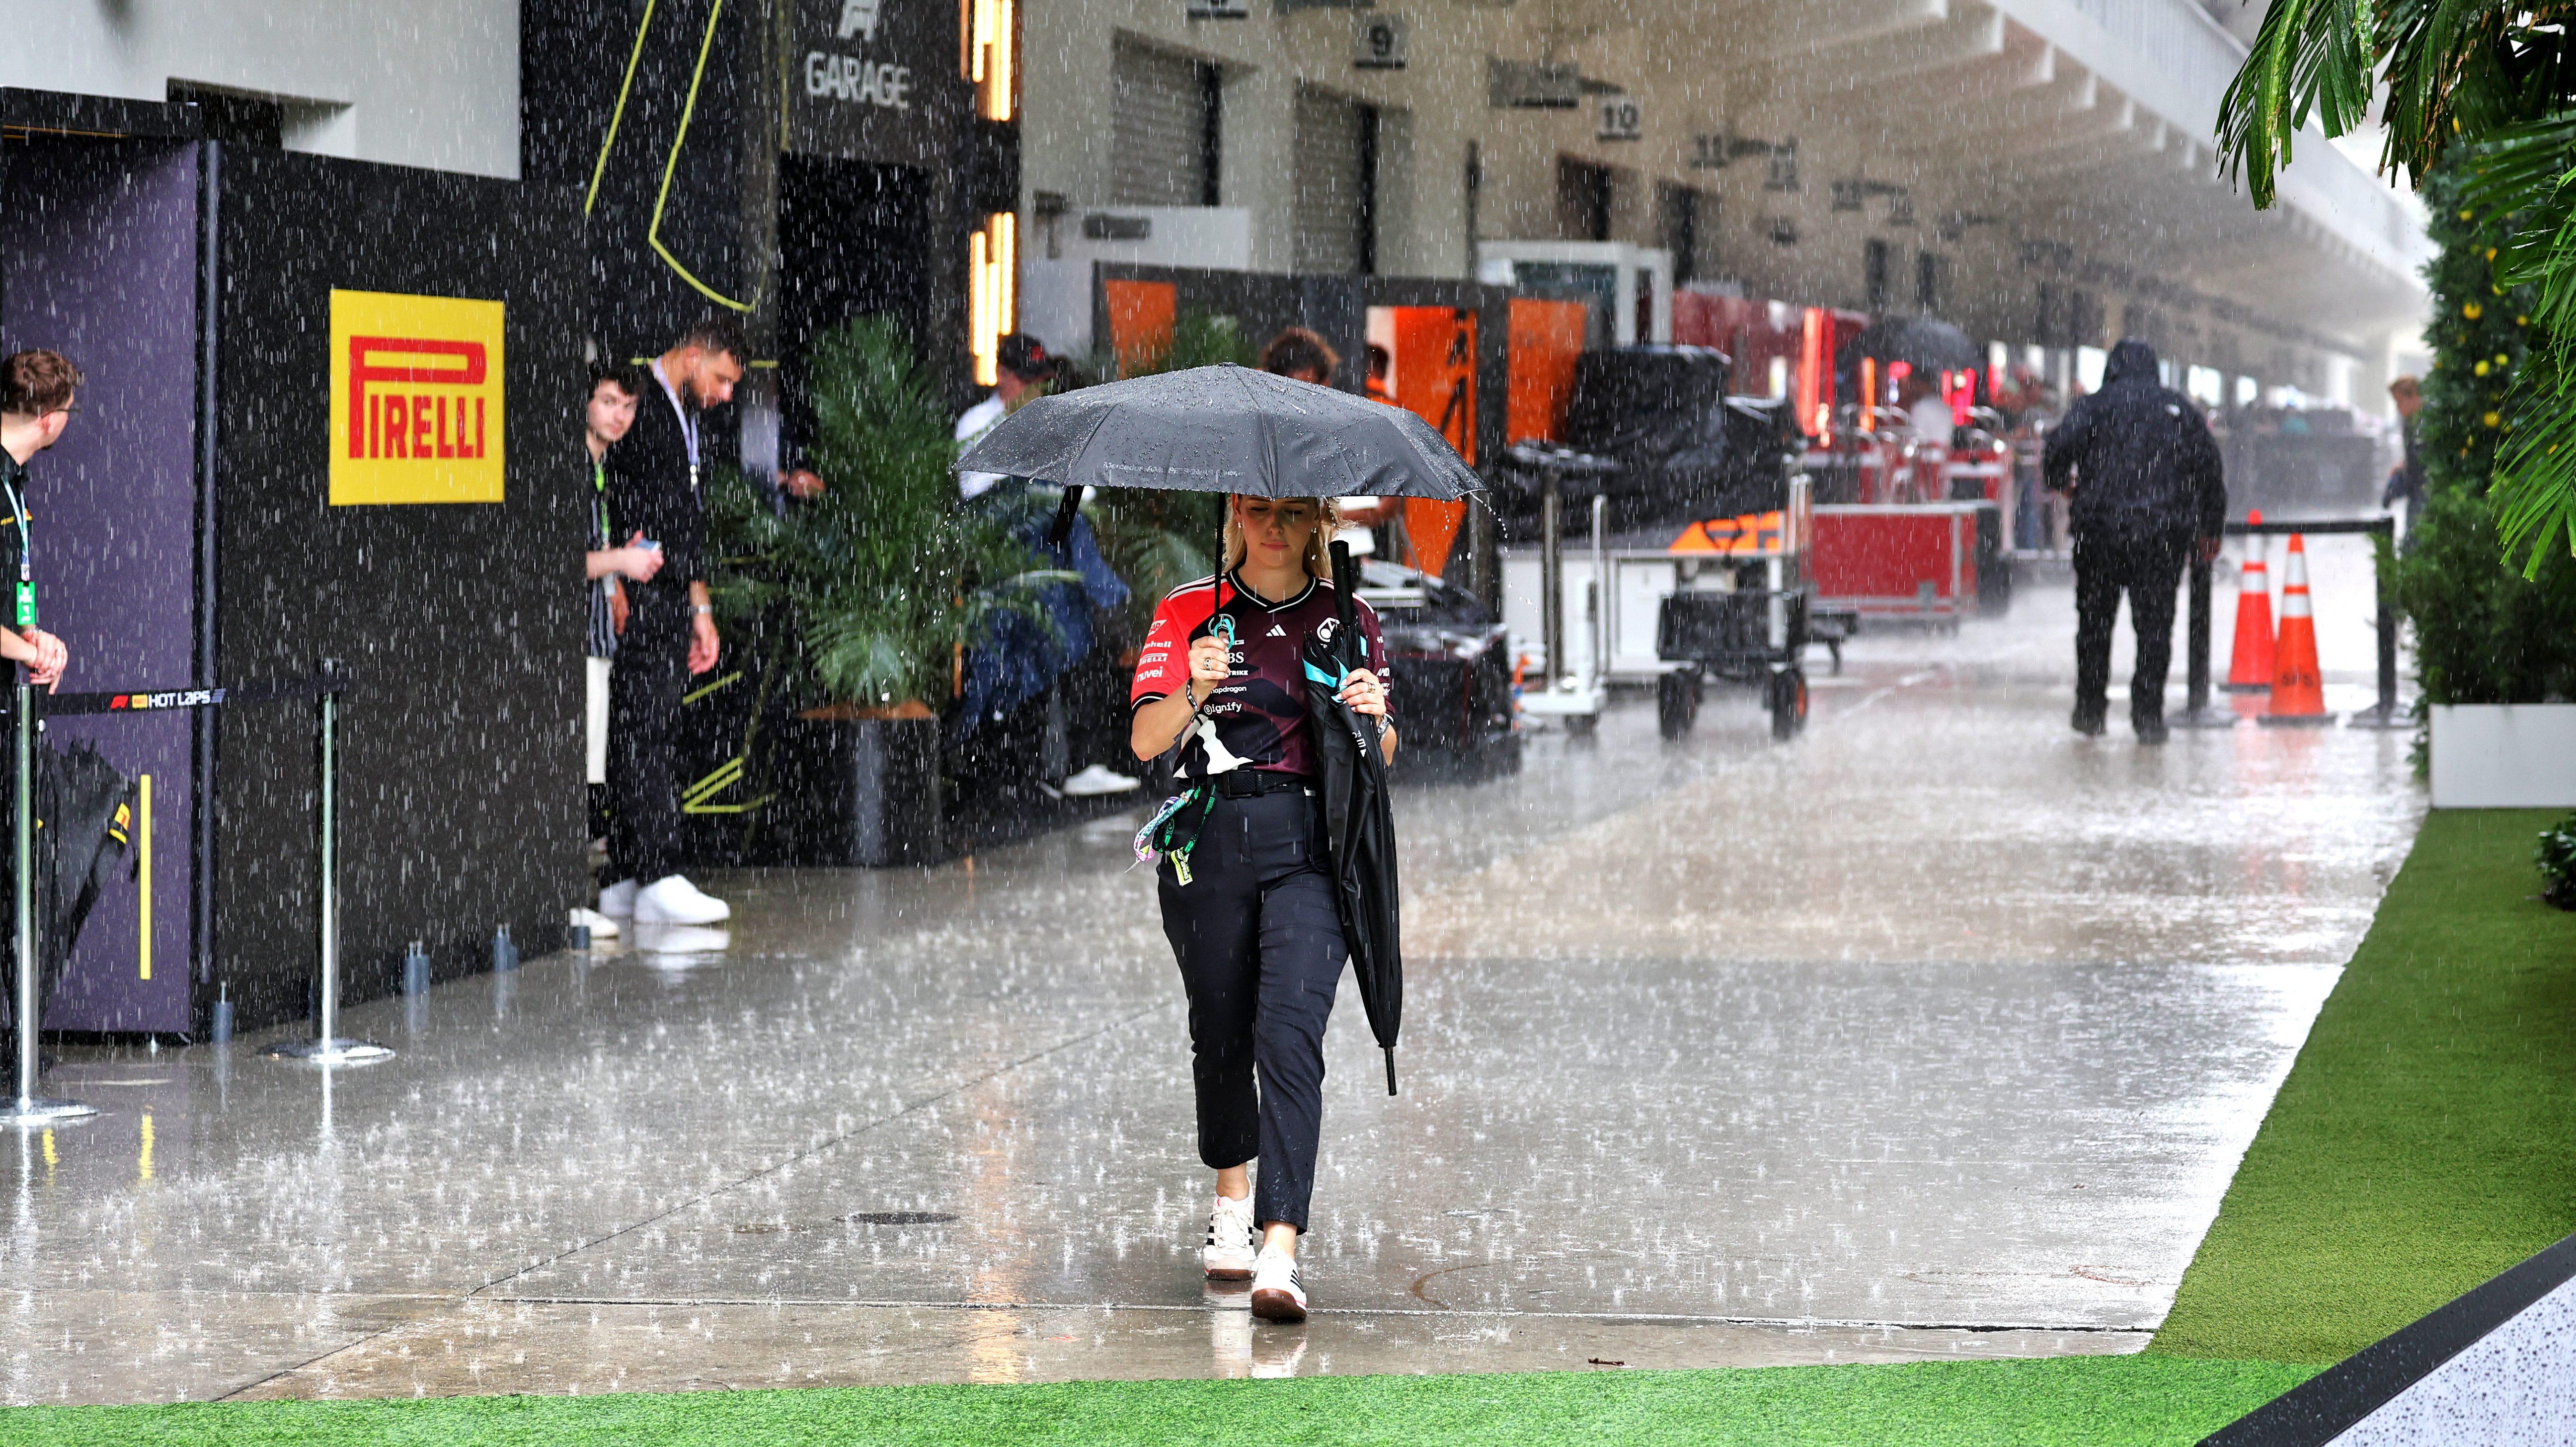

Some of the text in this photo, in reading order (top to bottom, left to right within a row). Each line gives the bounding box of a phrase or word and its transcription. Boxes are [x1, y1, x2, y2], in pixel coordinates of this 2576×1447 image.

[1373, 25, 1390, 57] 9
[804, 51, 910, 110] GARAGE
[1602, 104, 1639, 131] 10
[349, 335, 486, 459] PIRELLI
[1228, 651, 1245, 664] BS
[1136, 665, 1163, 683] nuvei
[1376, 667, 1390, 677] AMD
[1211, 686, 1247, 694] napdragon
[149, 693, 176, 708] HOT
